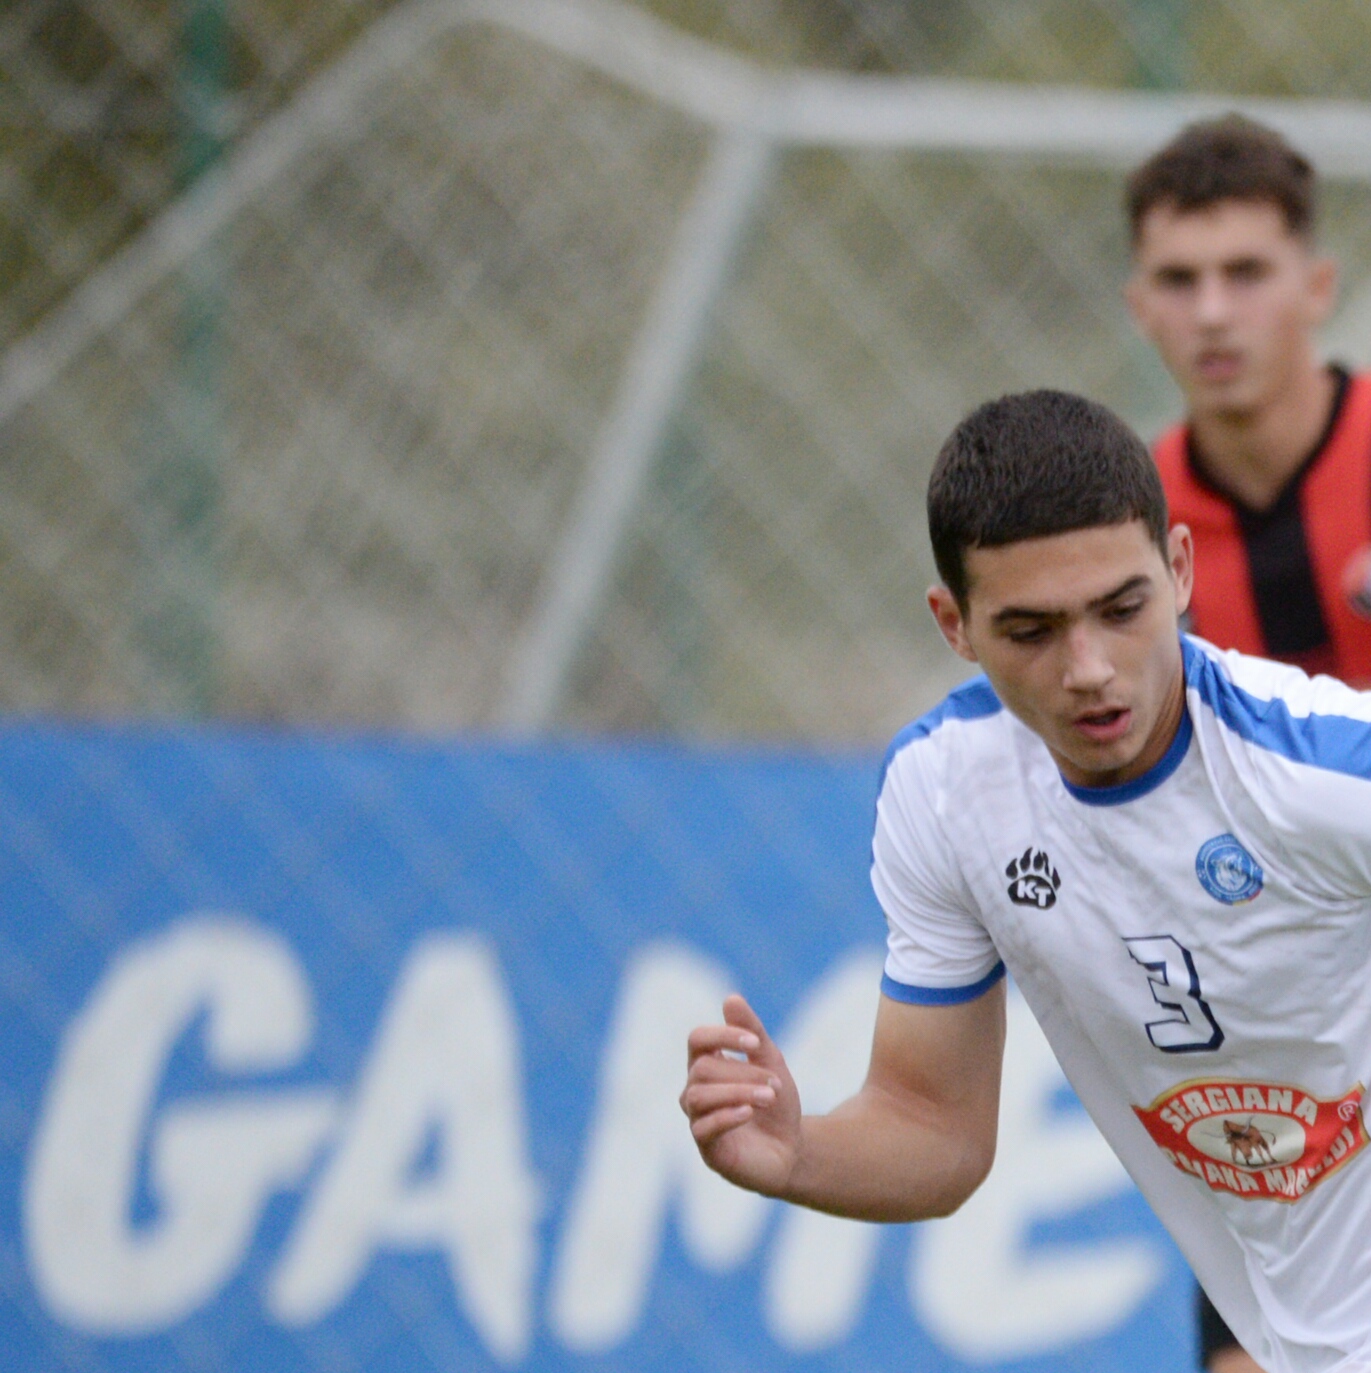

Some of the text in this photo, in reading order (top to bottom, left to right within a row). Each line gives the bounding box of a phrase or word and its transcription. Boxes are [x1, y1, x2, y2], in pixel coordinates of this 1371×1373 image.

[1017, 880, 1052, 907] KT
[1121, 934, 1225, 1053] 3
[1159, 1086, 1318, 1134] SERGIANA
